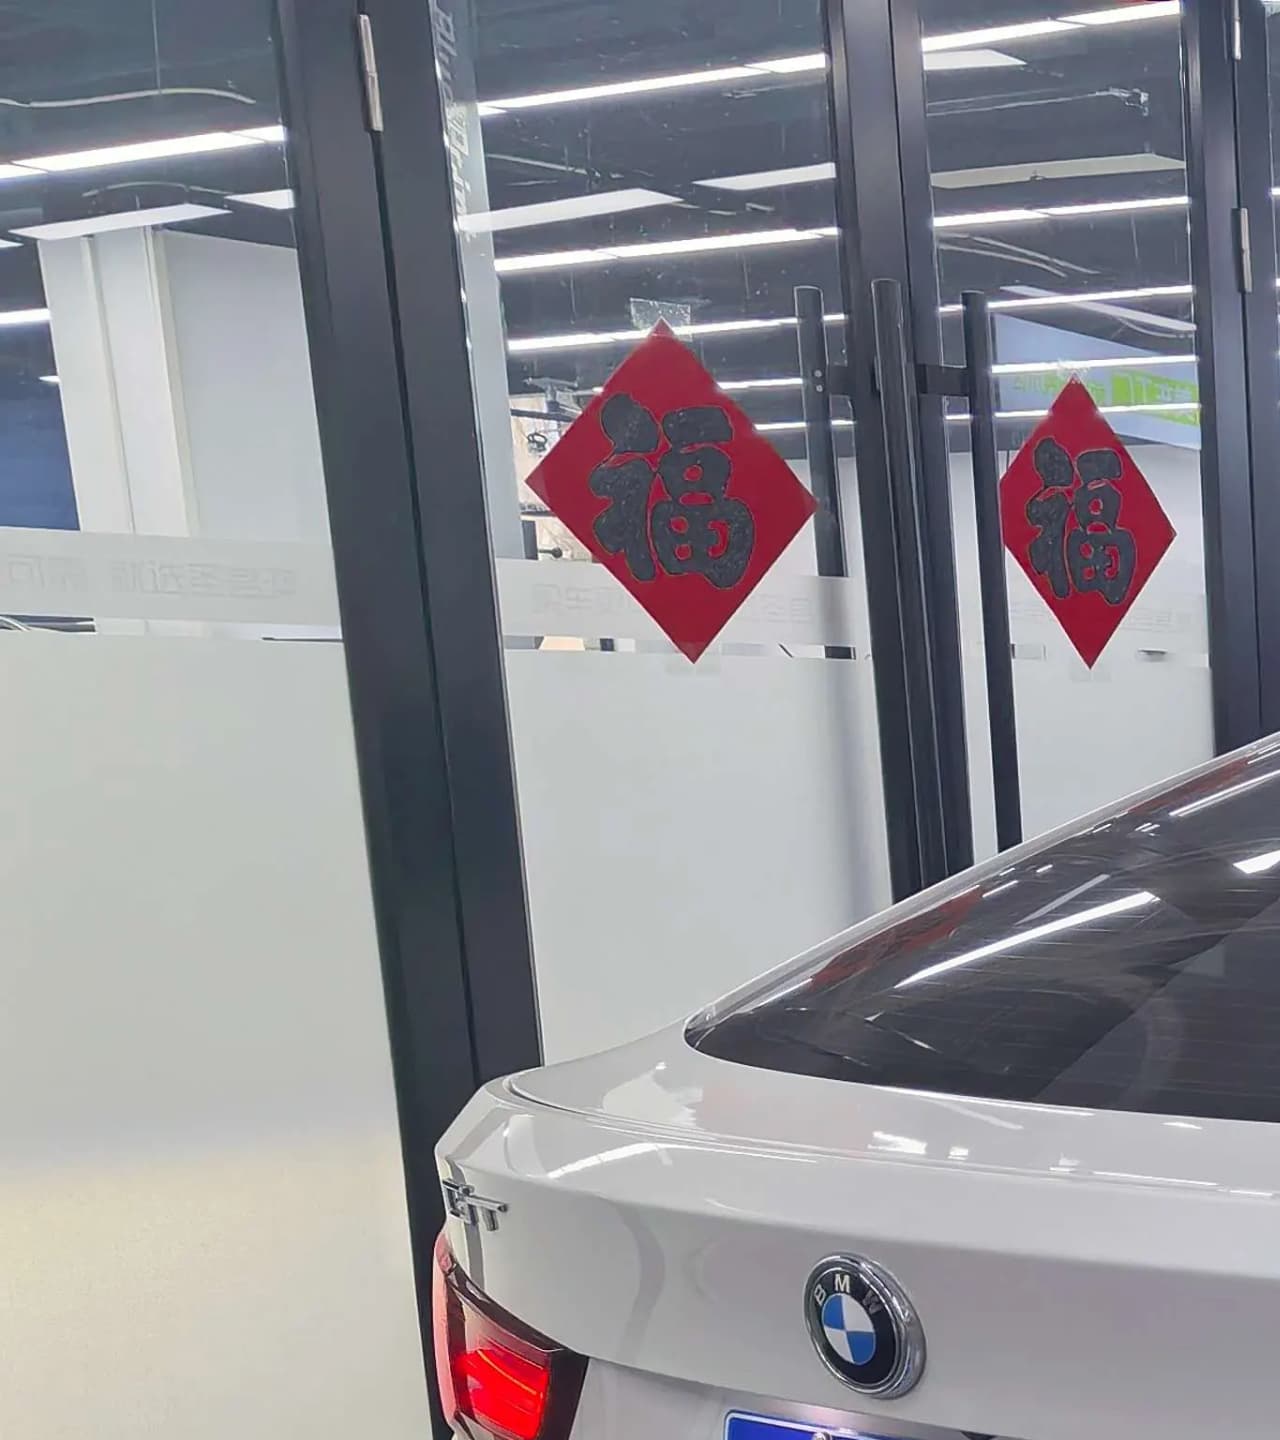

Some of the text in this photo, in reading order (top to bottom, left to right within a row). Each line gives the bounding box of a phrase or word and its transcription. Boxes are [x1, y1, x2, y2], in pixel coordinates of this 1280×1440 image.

[589, 393, 756, 590] 福
[1026, 437, 1136, 605] 福
[814, 1273, 882, 1315] BMW
